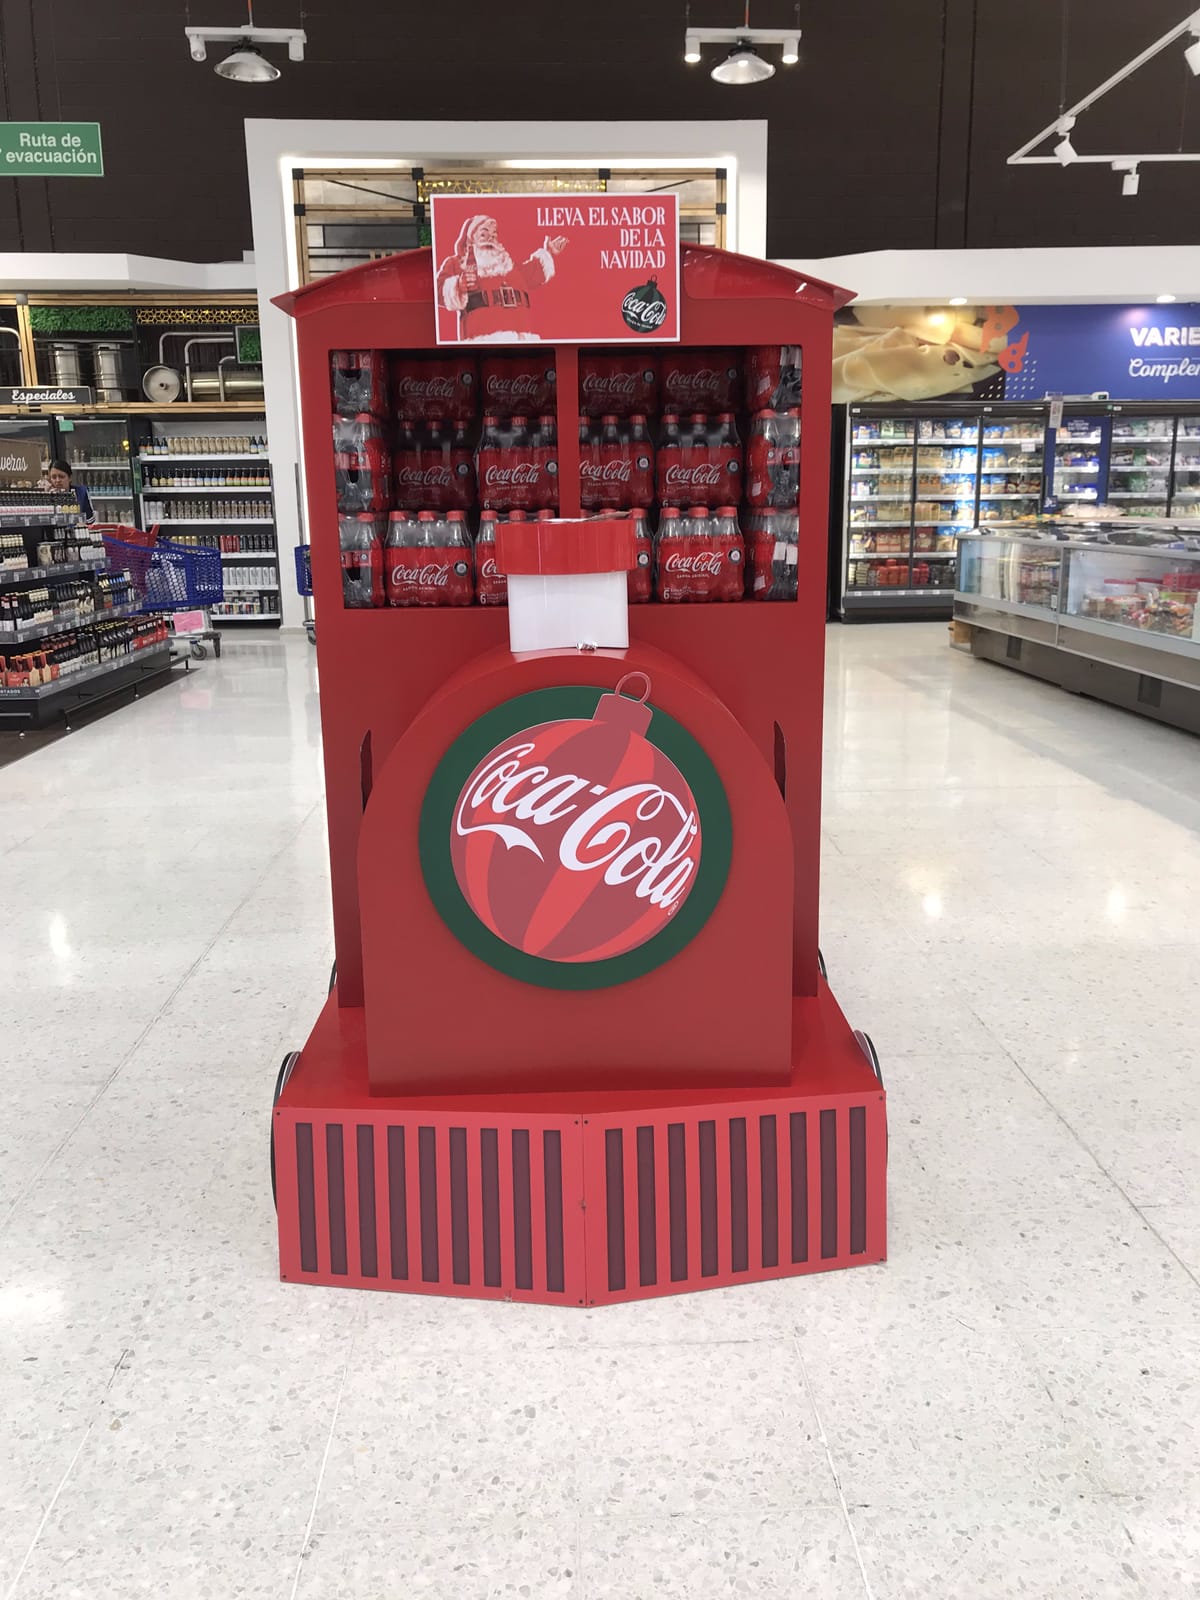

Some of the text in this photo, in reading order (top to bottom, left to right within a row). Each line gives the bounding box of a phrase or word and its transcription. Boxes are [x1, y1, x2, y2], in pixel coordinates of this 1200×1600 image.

[19, 132, 81, 147] Ruta de
[5, 148, 97, 163] evacuación
[537, 205, 665, 226] LLEVA EL SABOR
[620, 228, 666, 247] DE LA
[600, 250, 666, 269] NAVIDAD
[1129, 326, 1200, 347] VARIE
[400, 376, 455, 398] Coca-Cola
[486, 374, 539, 395] Coca-Cola
[12, 389, 76, 404] Especiales
[400, 465, 452, 486] Coca-Cola
[485, 463, 541, 485] Coca-Cola
[579, 459, 632, 482] Coca-Cola
[665, 463, 722, 485] Coca-Cola
[665, 551, 724, 576] Coca-Cola
[391, 563, 449, 586] Coca-Cola
[663, 589, 670, 600] 6
[457, 743, 697, 909] Coca-Cola
